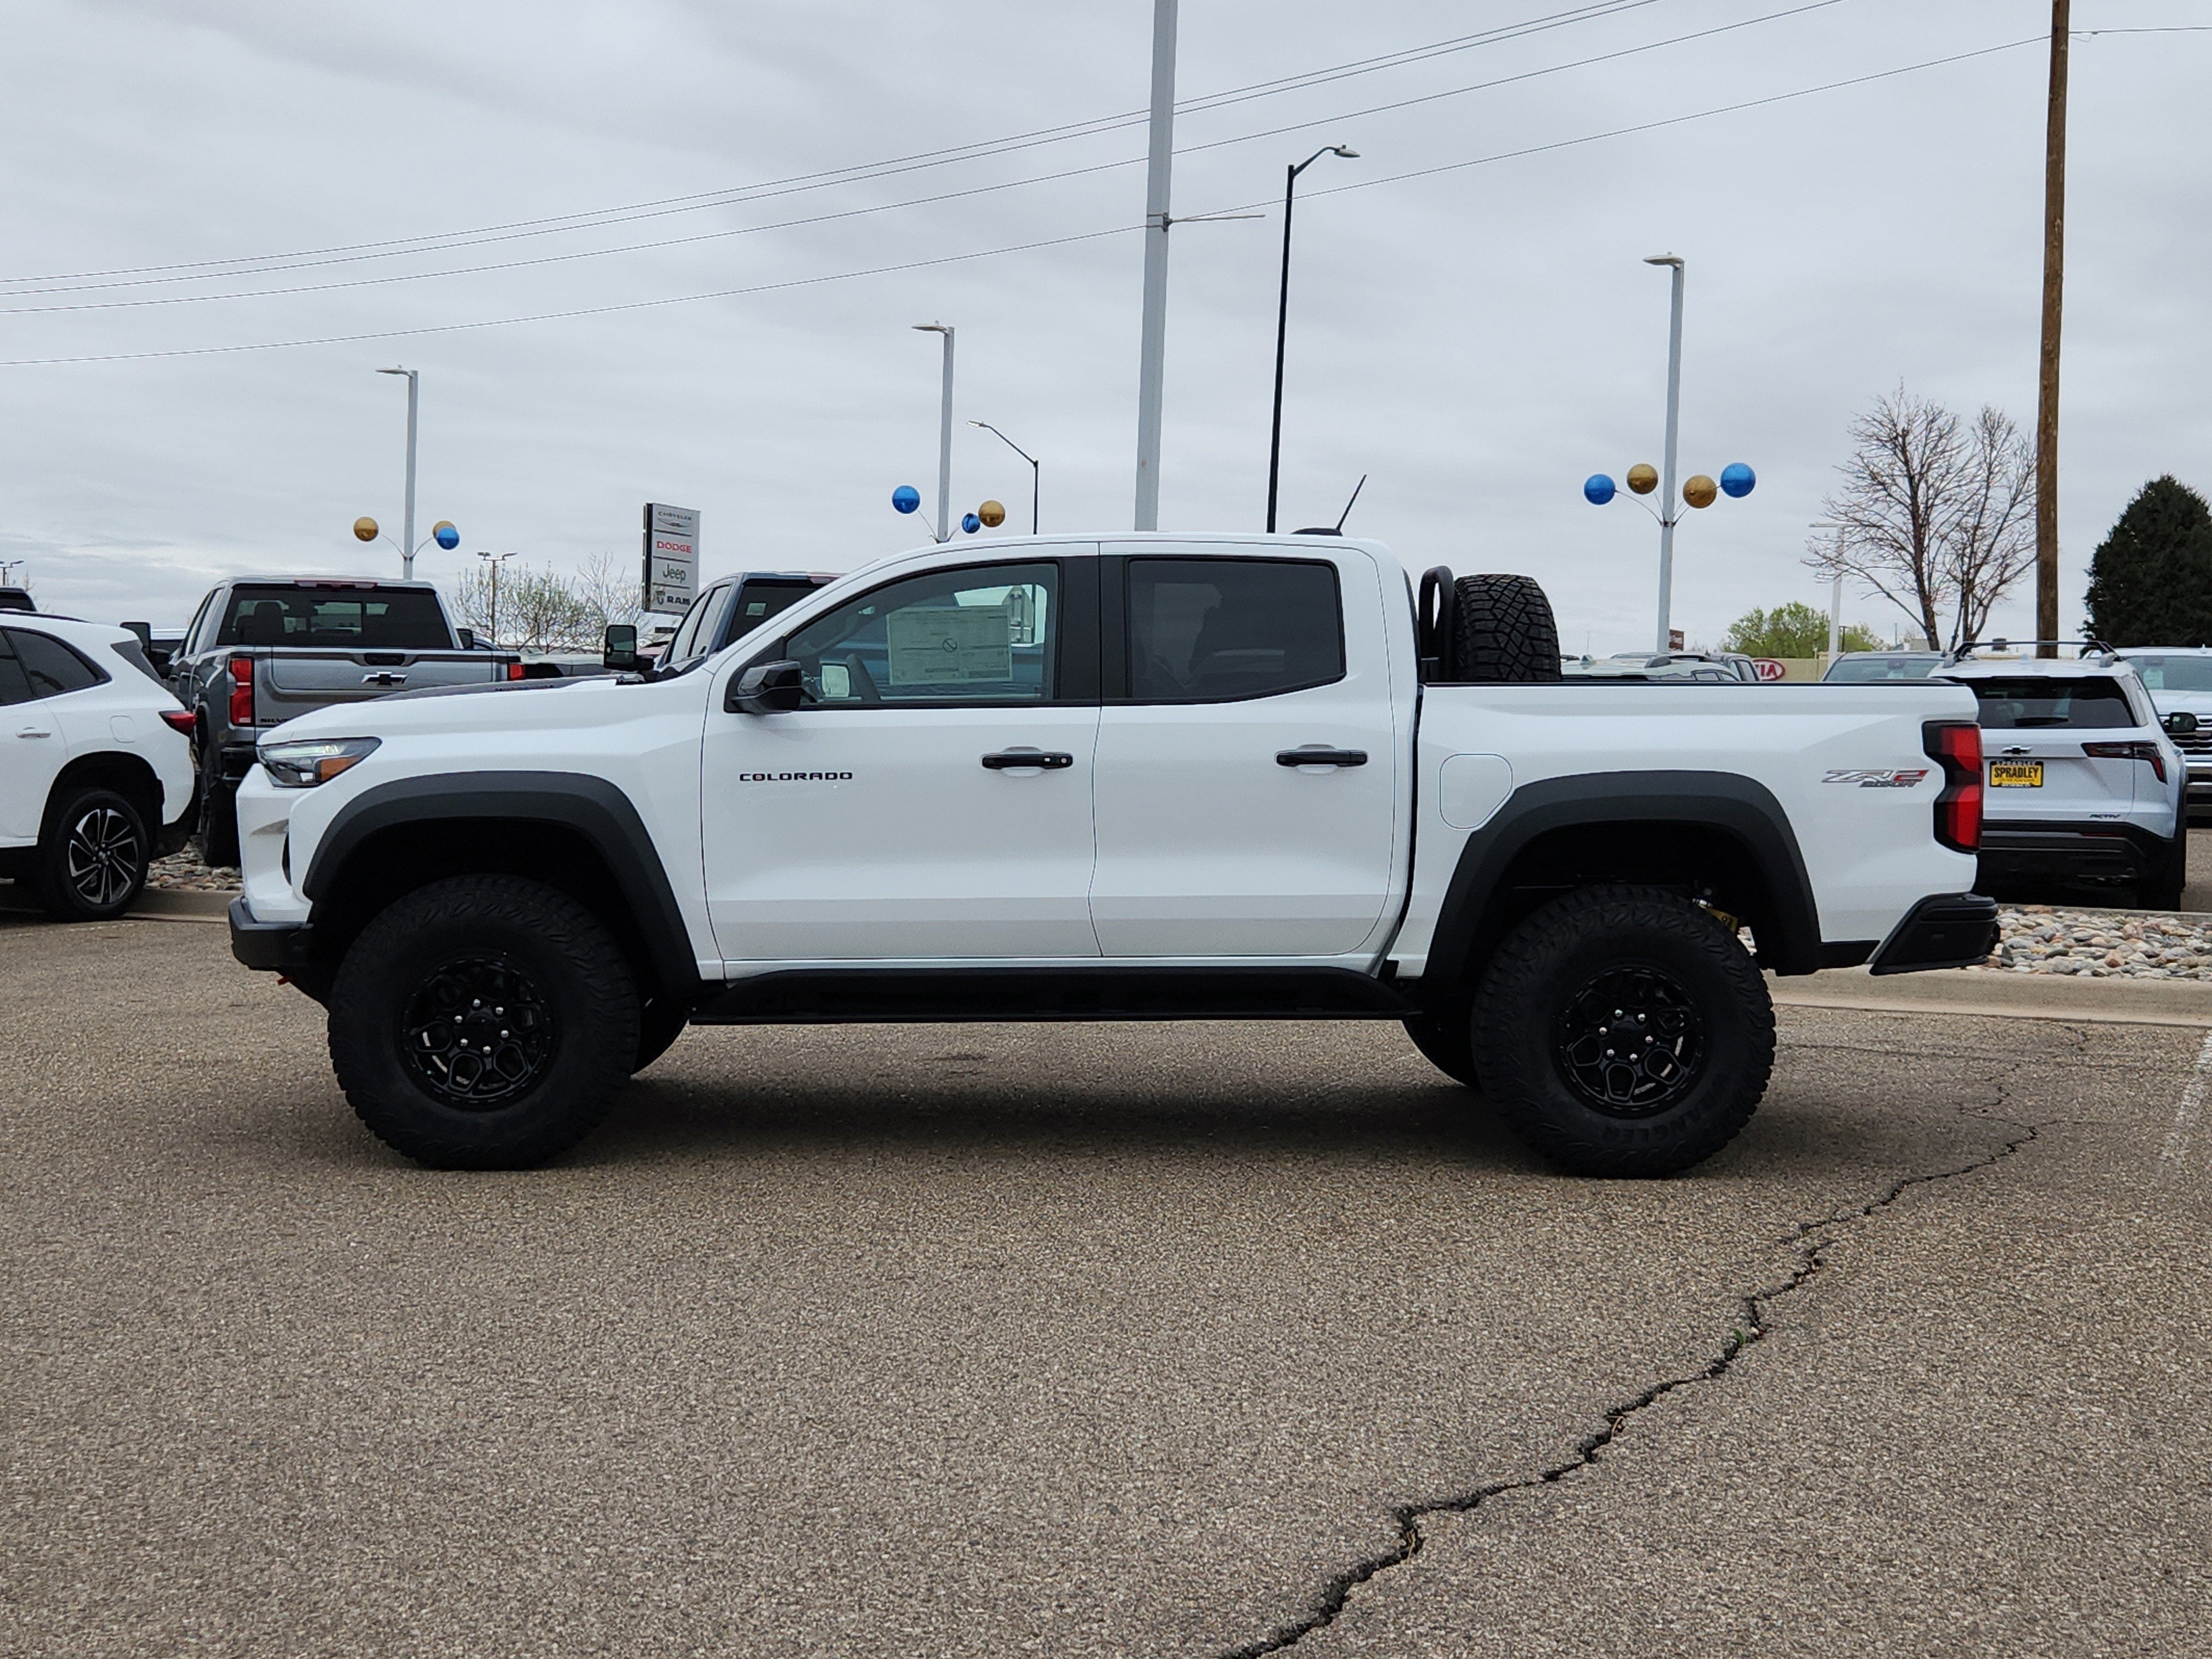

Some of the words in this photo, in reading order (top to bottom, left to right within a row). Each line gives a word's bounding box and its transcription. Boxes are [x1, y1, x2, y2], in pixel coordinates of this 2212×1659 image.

[658, 511, 692, 520] CHRYSLER
[657, 541, 692, 554] DODGE
[663, 563, 686, 583] Jeep
[667, 595, 691, 606] RAM
[739, 772, 853, 781] COLORADO
[1821, 769, 1930, 783] ZR2
[1994, 767, 2039, 779] SPRADLEY
